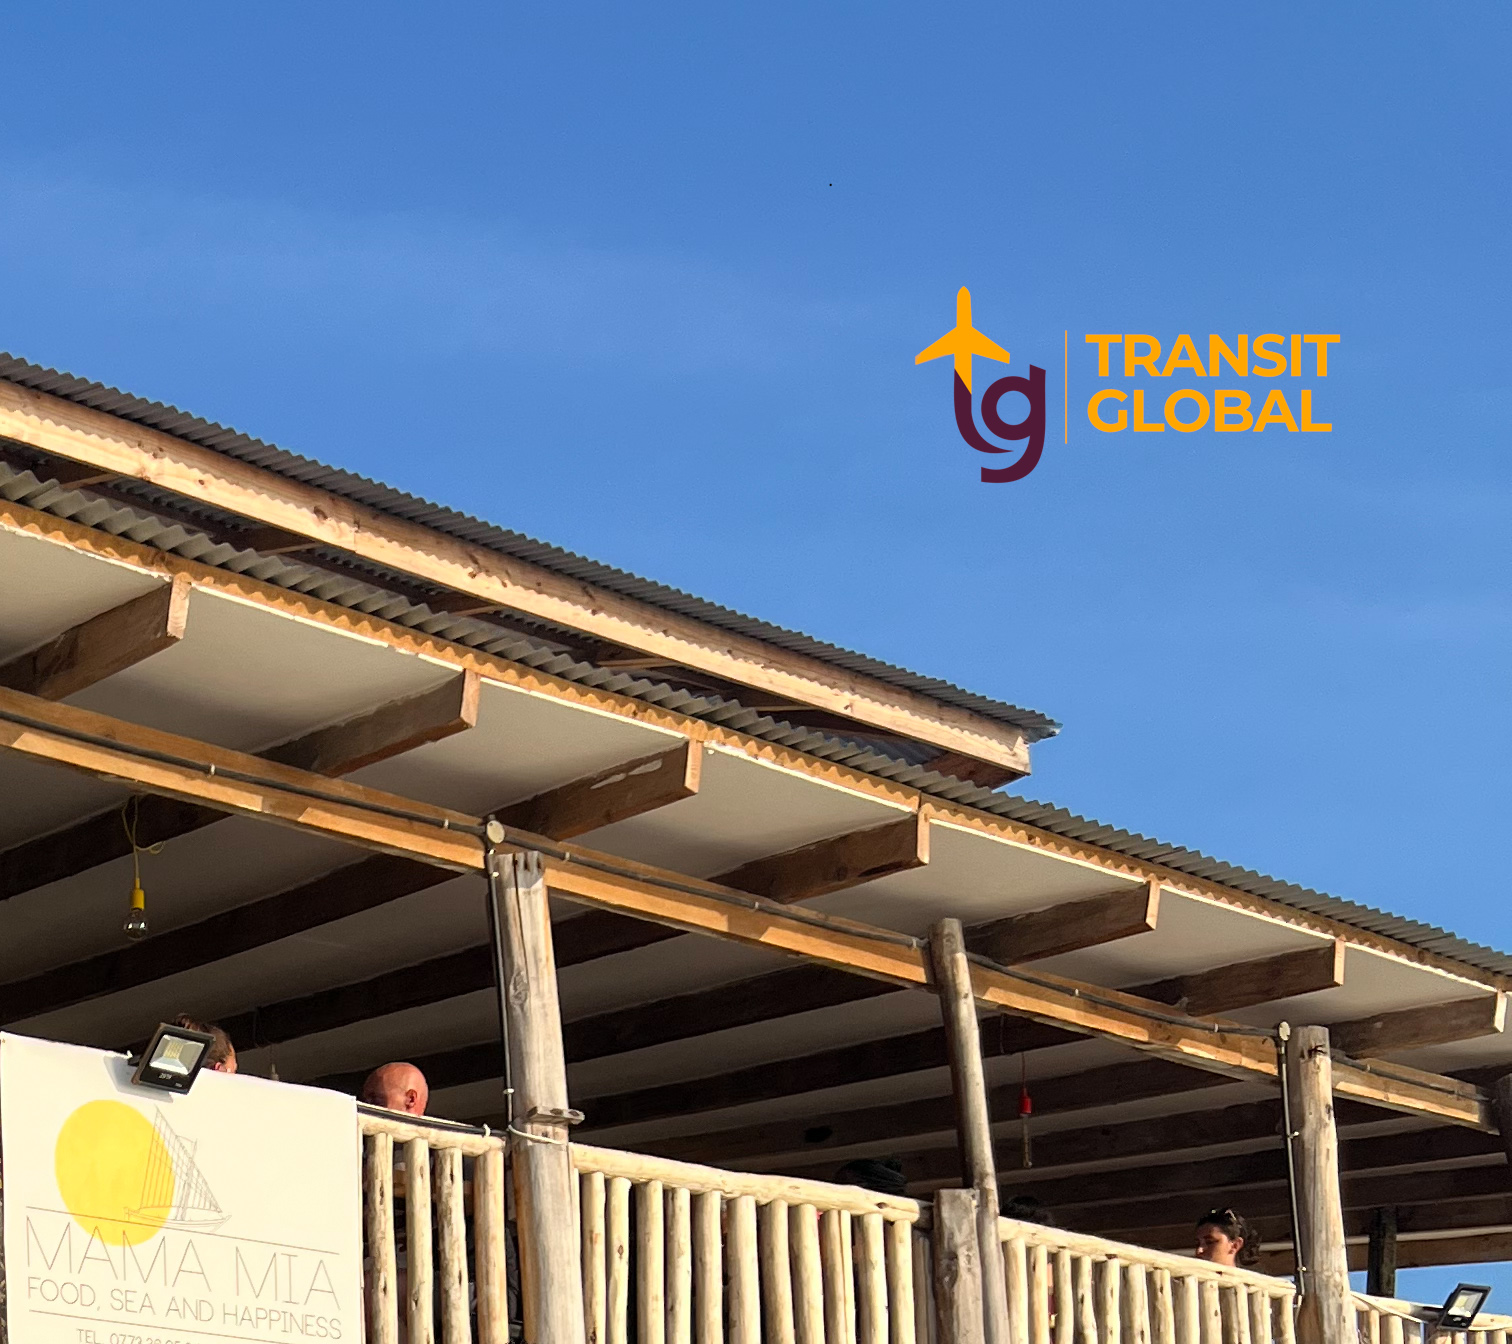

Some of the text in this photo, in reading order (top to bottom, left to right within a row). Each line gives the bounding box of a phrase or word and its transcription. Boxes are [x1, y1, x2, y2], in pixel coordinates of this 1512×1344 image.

[25, 1215, 342, 1312] MAMA MIA
[27, 1276, 343, 1340] FOOD, SEA AND HAPPINESS
